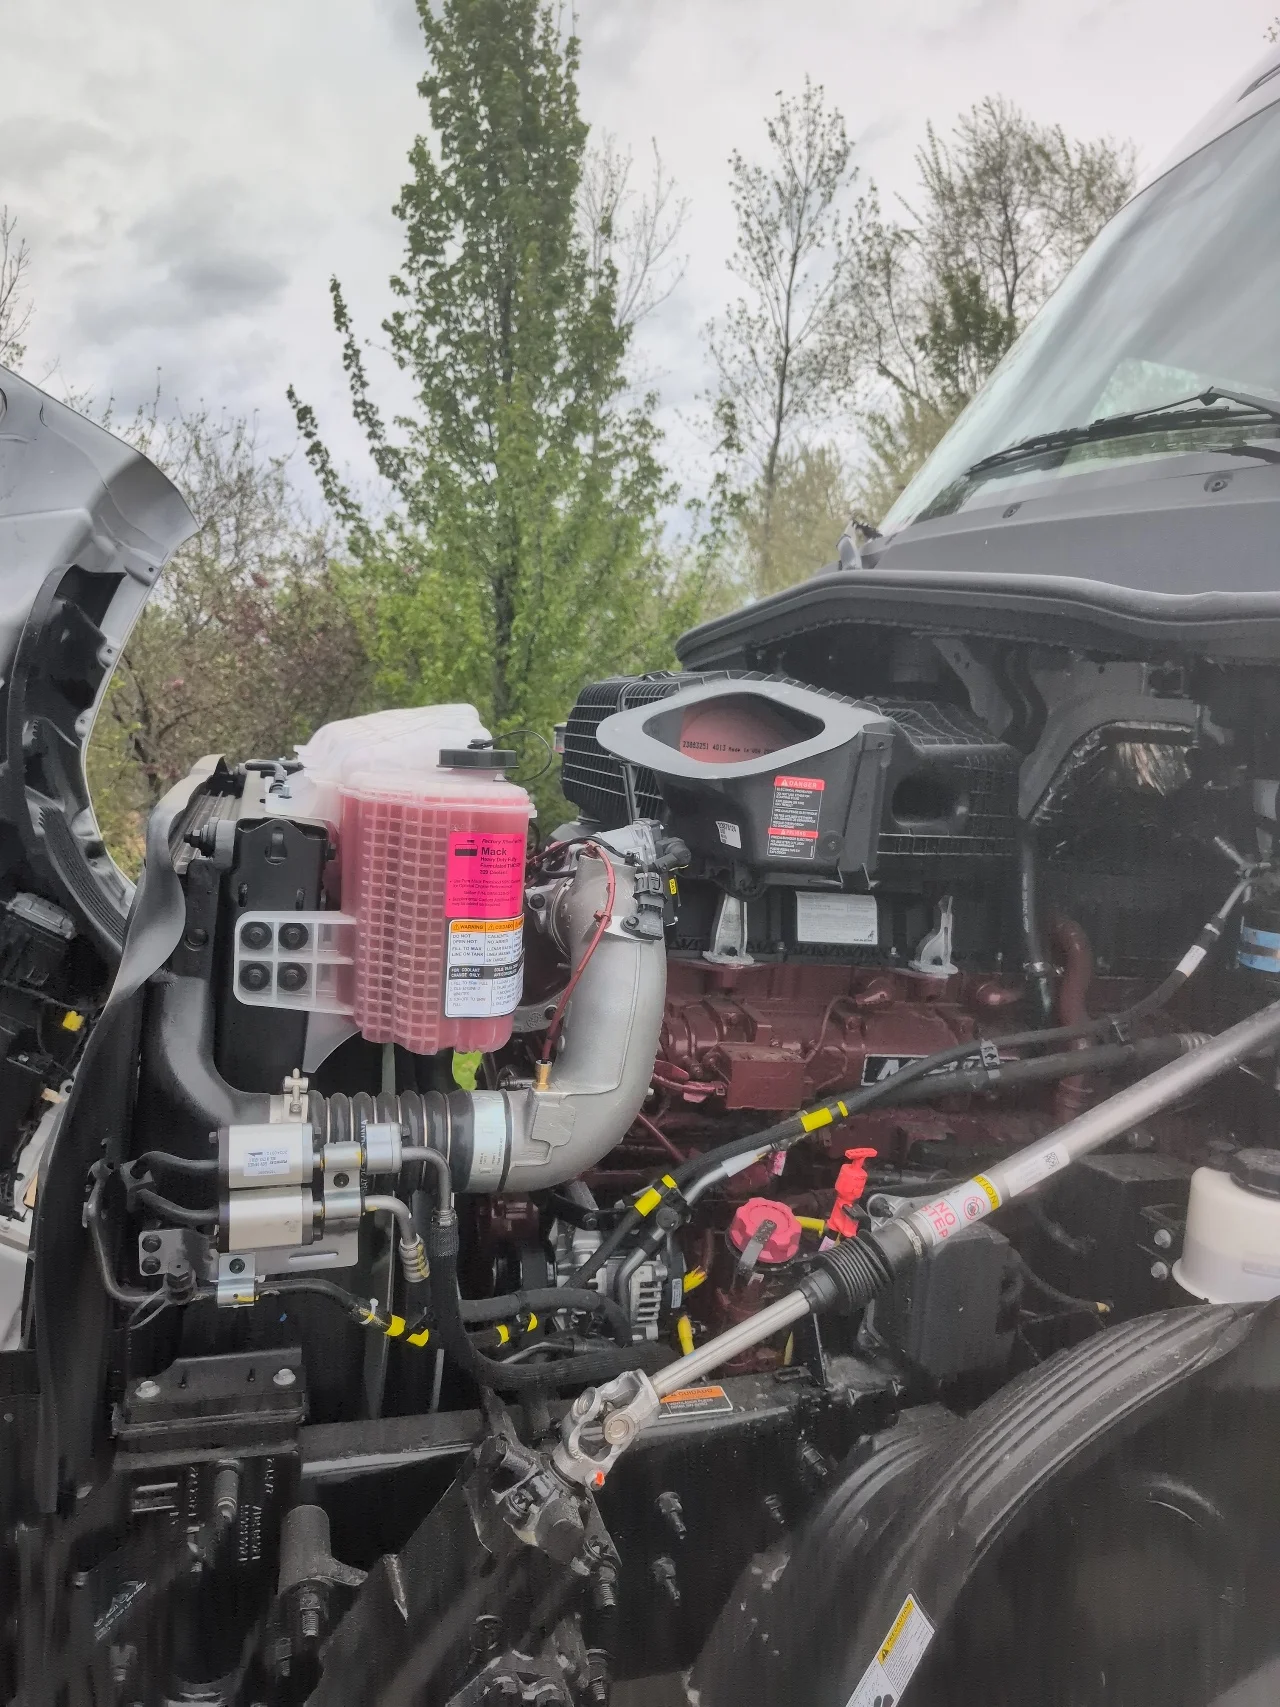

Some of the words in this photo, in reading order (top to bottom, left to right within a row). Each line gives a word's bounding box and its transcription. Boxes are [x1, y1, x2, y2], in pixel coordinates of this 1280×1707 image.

[789, 780, 817, 788] DANGER
[482, 847, 507, 855] Mack
[921, 1204, 949, 1239] STEP
[934, 1201, 956, 1226] NO
